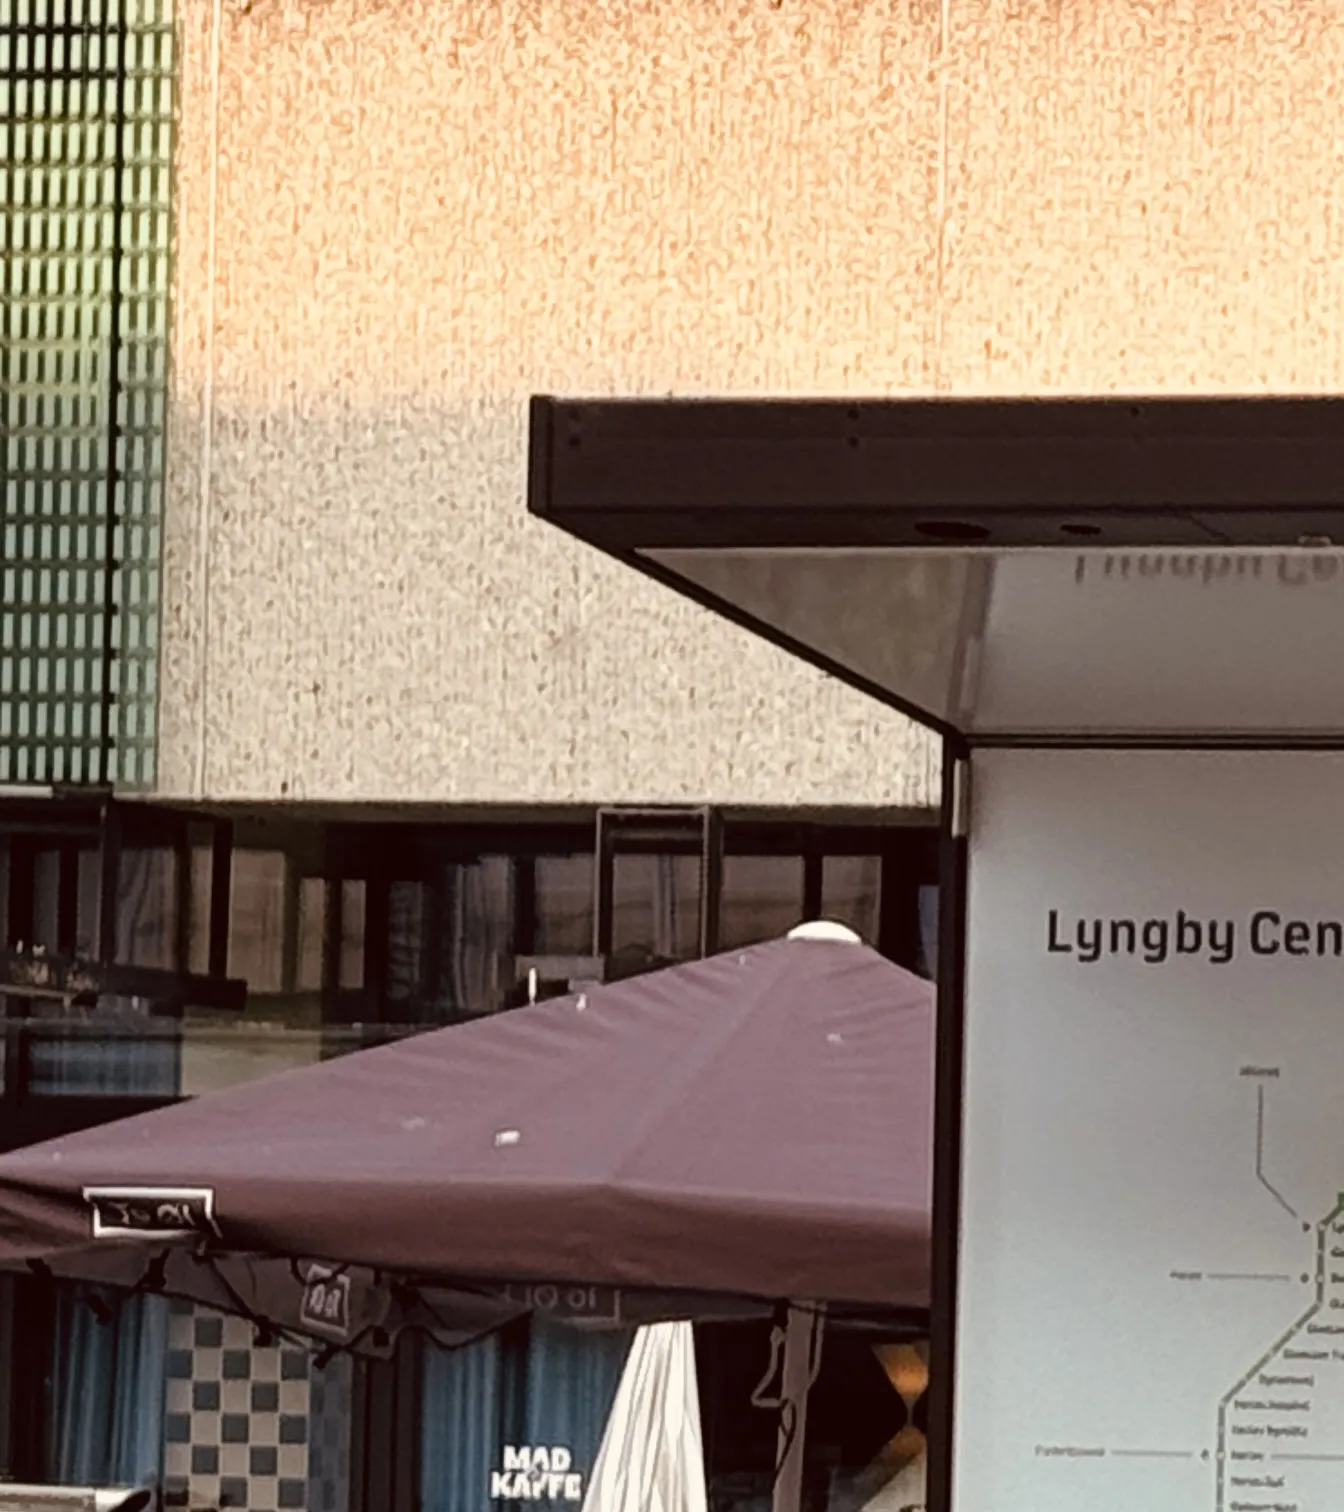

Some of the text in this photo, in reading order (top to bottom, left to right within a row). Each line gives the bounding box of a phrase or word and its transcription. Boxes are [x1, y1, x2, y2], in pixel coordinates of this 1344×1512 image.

[1047, 909, 1235, 964] Lyngby
[503, 1445, 572, 1471] MAD
[491, 1471, 581, 1500] KAFFE
